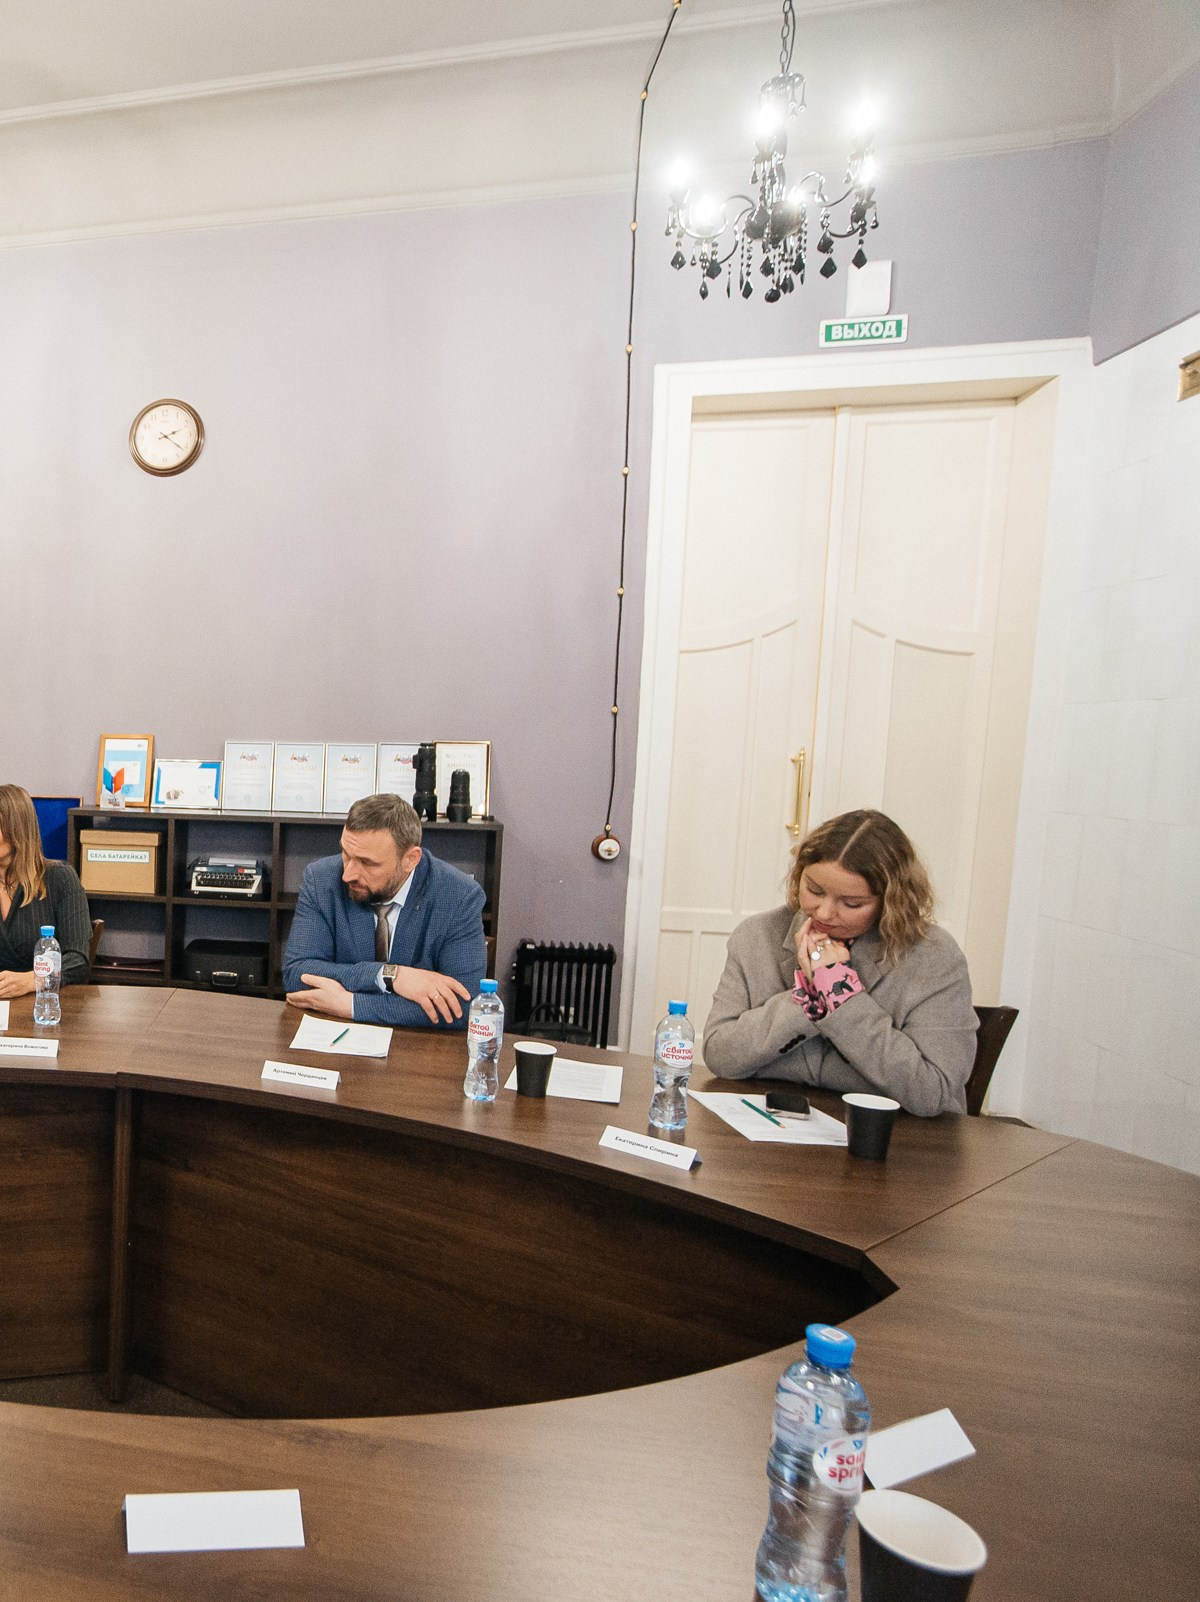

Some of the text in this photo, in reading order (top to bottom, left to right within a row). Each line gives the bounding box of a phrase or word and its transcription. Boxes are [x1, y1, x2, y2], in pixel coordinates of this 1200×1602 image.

[831, 320, 897, 340] ВЫХОД
[468, 1020, 490, 1031] вятой
[661, 1051, 693, 1061] источни
